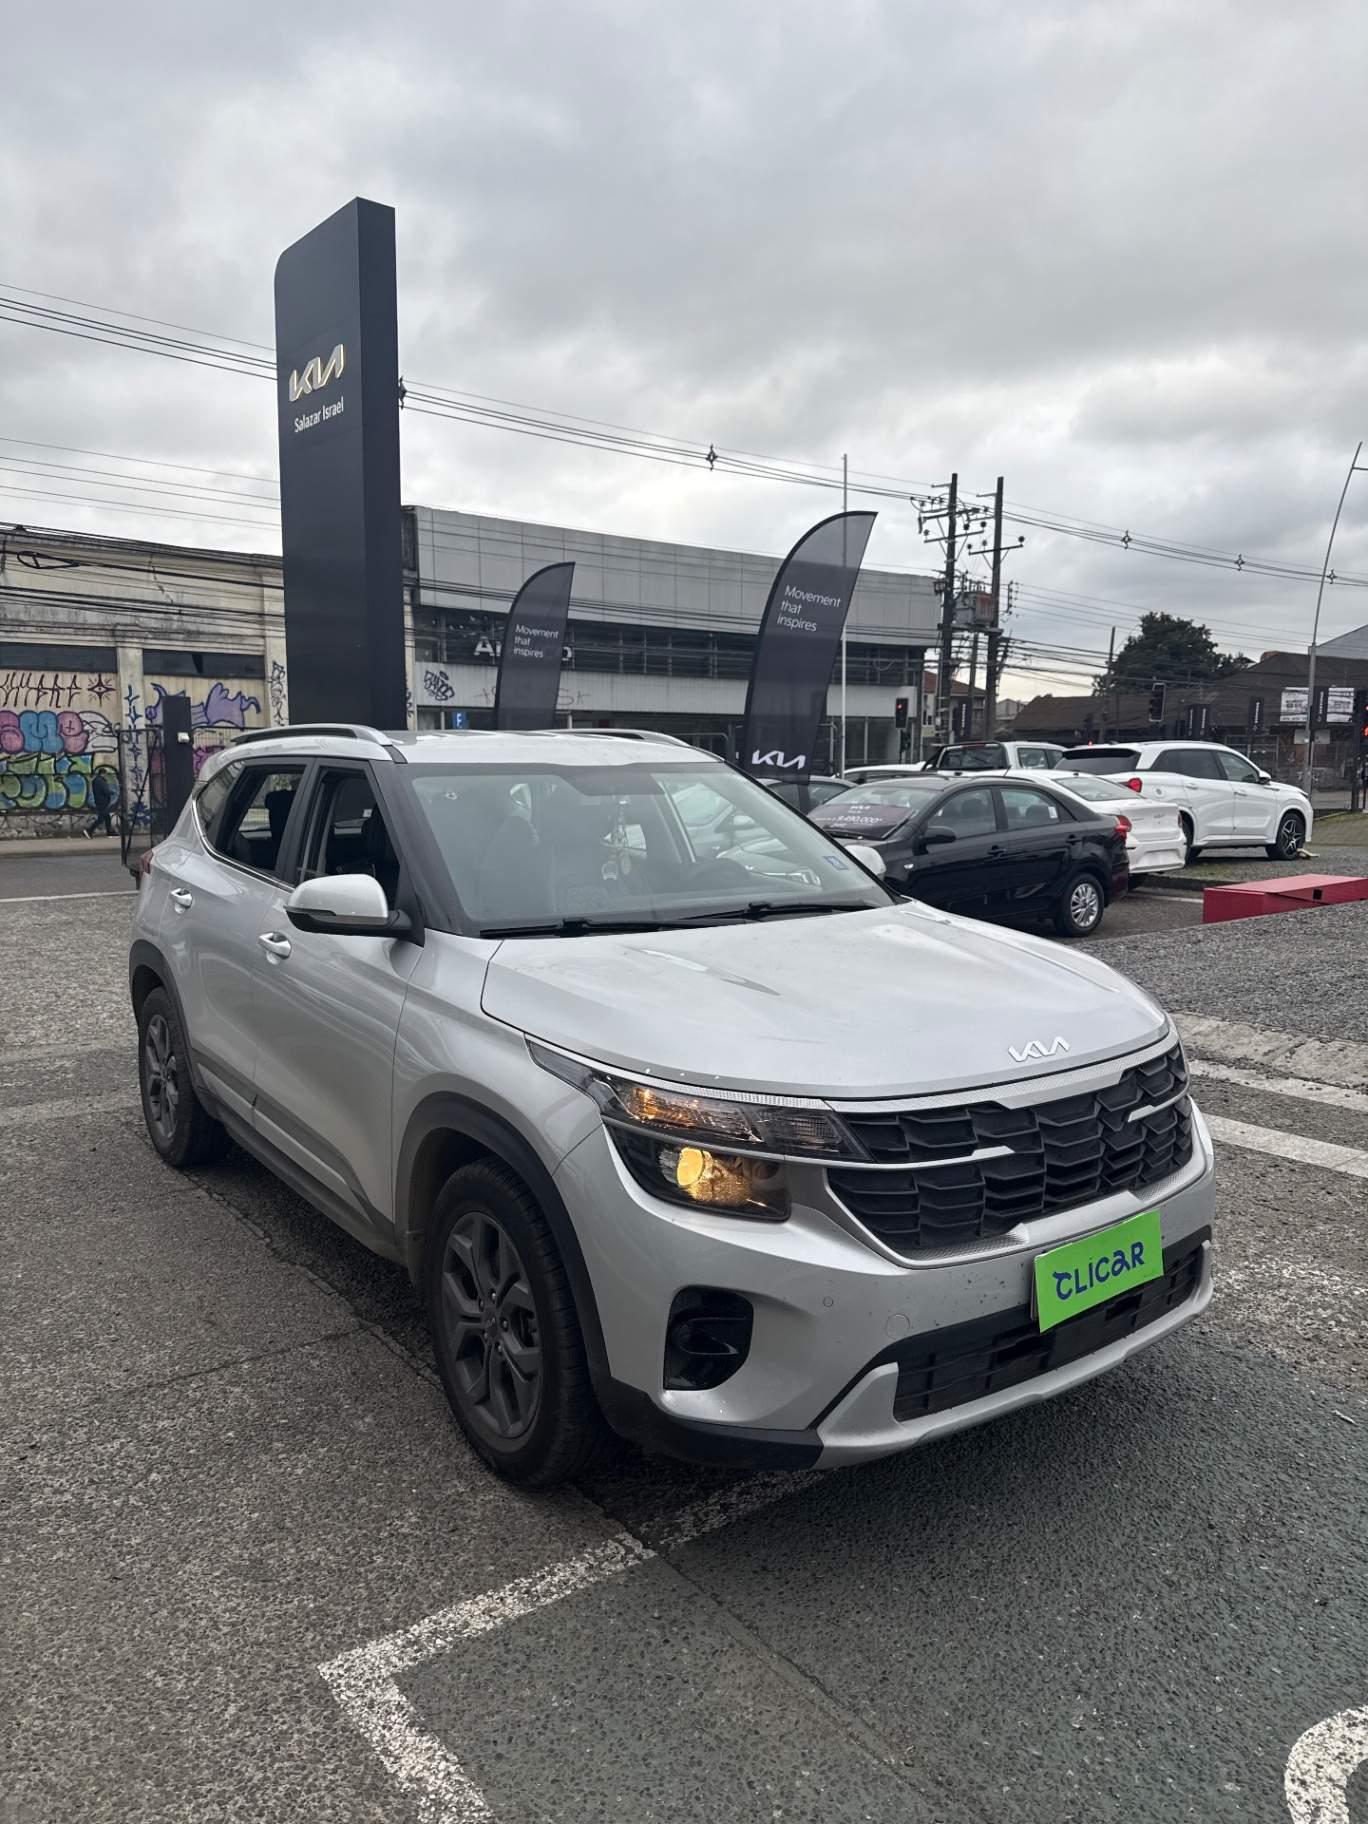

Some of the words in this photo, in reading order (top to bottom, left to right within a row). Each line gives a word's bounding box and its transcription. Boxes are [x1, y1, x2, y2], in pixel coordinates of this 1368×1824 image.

[289, 343, 345, 402] KIA
[294, 411, 321, 433] Salazar
[322, 396, 344, 421] Israel
[784, 584, 841, 608] Movement
[781, 600, 802, 615] that
[515, 623, 559, 639] Movement
[777, 613, 818, 632] inspires
[514, 636, 531, 646] that
[513, 647, 544, 658] inspires
[751, 749, 806, 770] KIA
[1008, 1035, 1071, 1063] KIA
